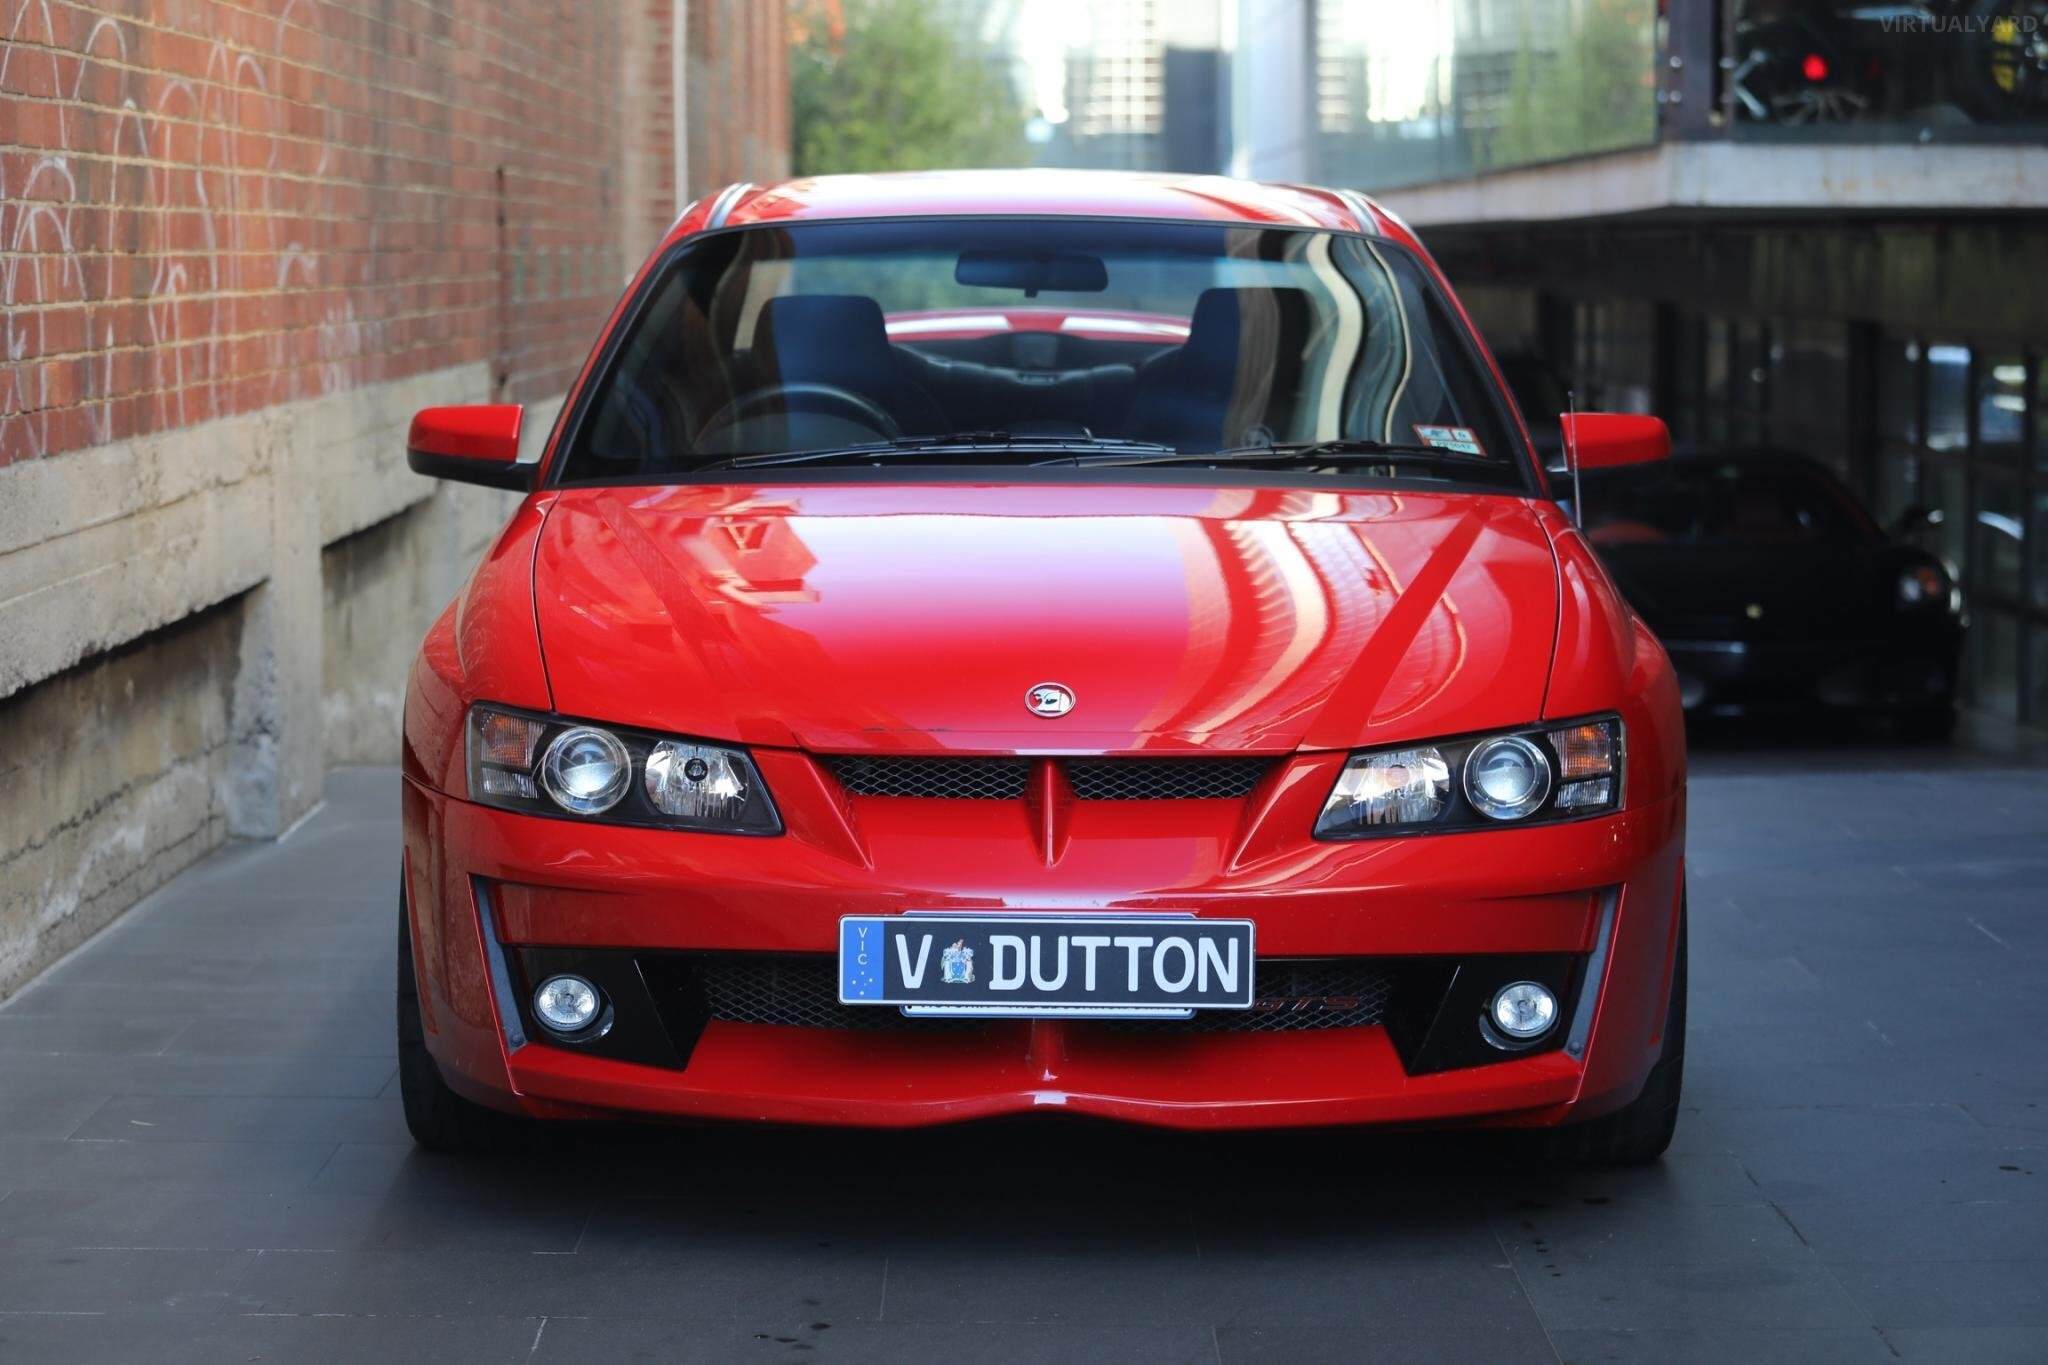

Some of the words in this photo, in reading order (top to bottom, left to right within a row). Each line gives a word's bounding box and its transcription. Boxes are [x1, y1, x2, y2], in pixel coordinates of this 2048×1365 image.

[858, 927, 868, 965] VIC
[895, 933, 933, 989] V
[989, 935, 1239, 993] DUTTON
